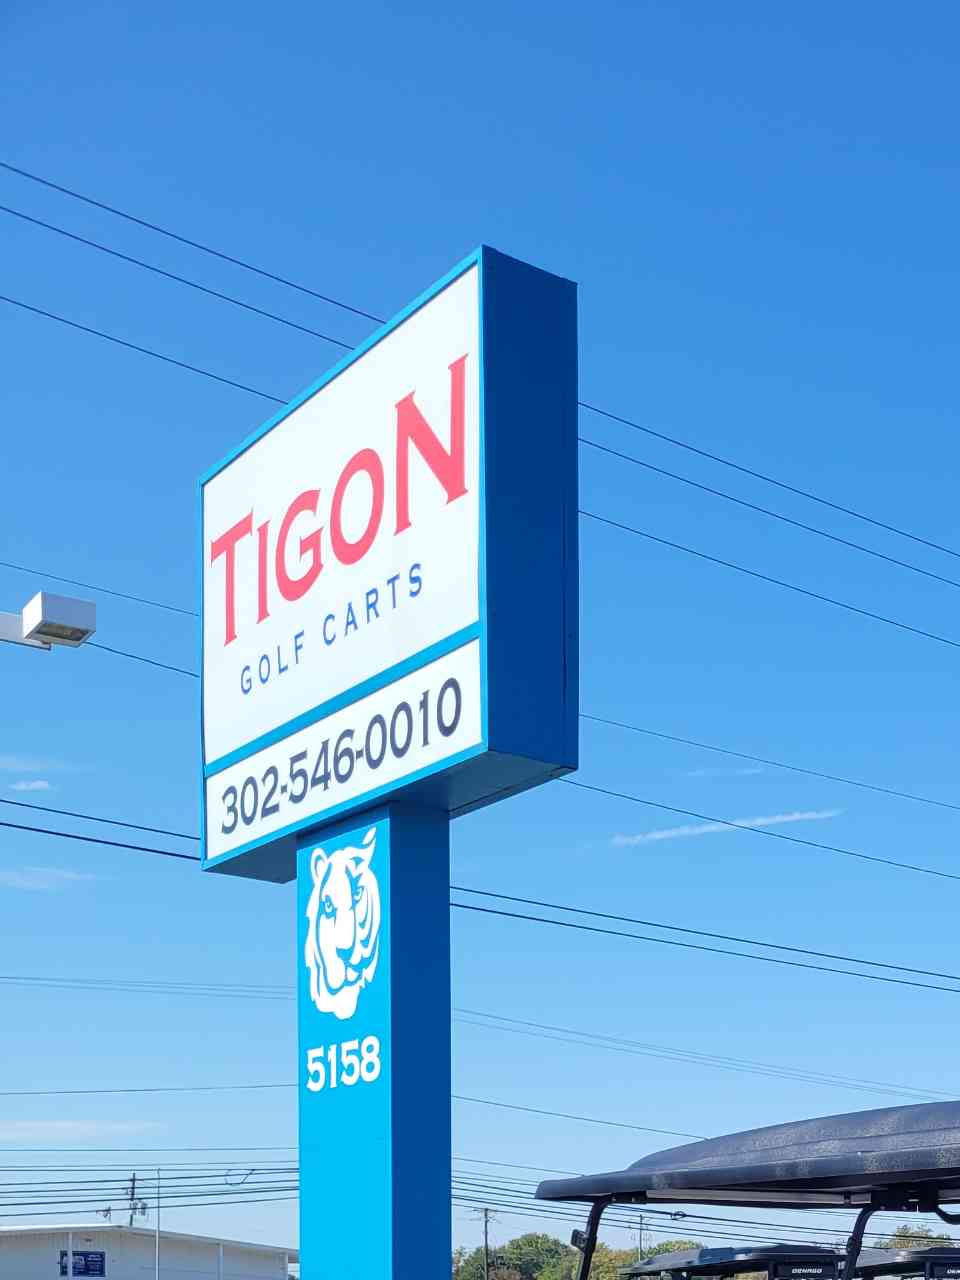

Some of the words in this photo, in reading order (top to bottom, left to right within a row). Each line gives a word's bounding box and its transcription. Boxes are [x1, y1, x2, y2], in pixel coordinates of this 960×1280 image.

[210, 352, 469, 648] TIGON
[240, 629, 305, 695] GOLF
[322, 562, 423, 646] CARTS
[220, 676, 463, 835] 302-546-0010
[307, 1035, 381, 1092] 5158
